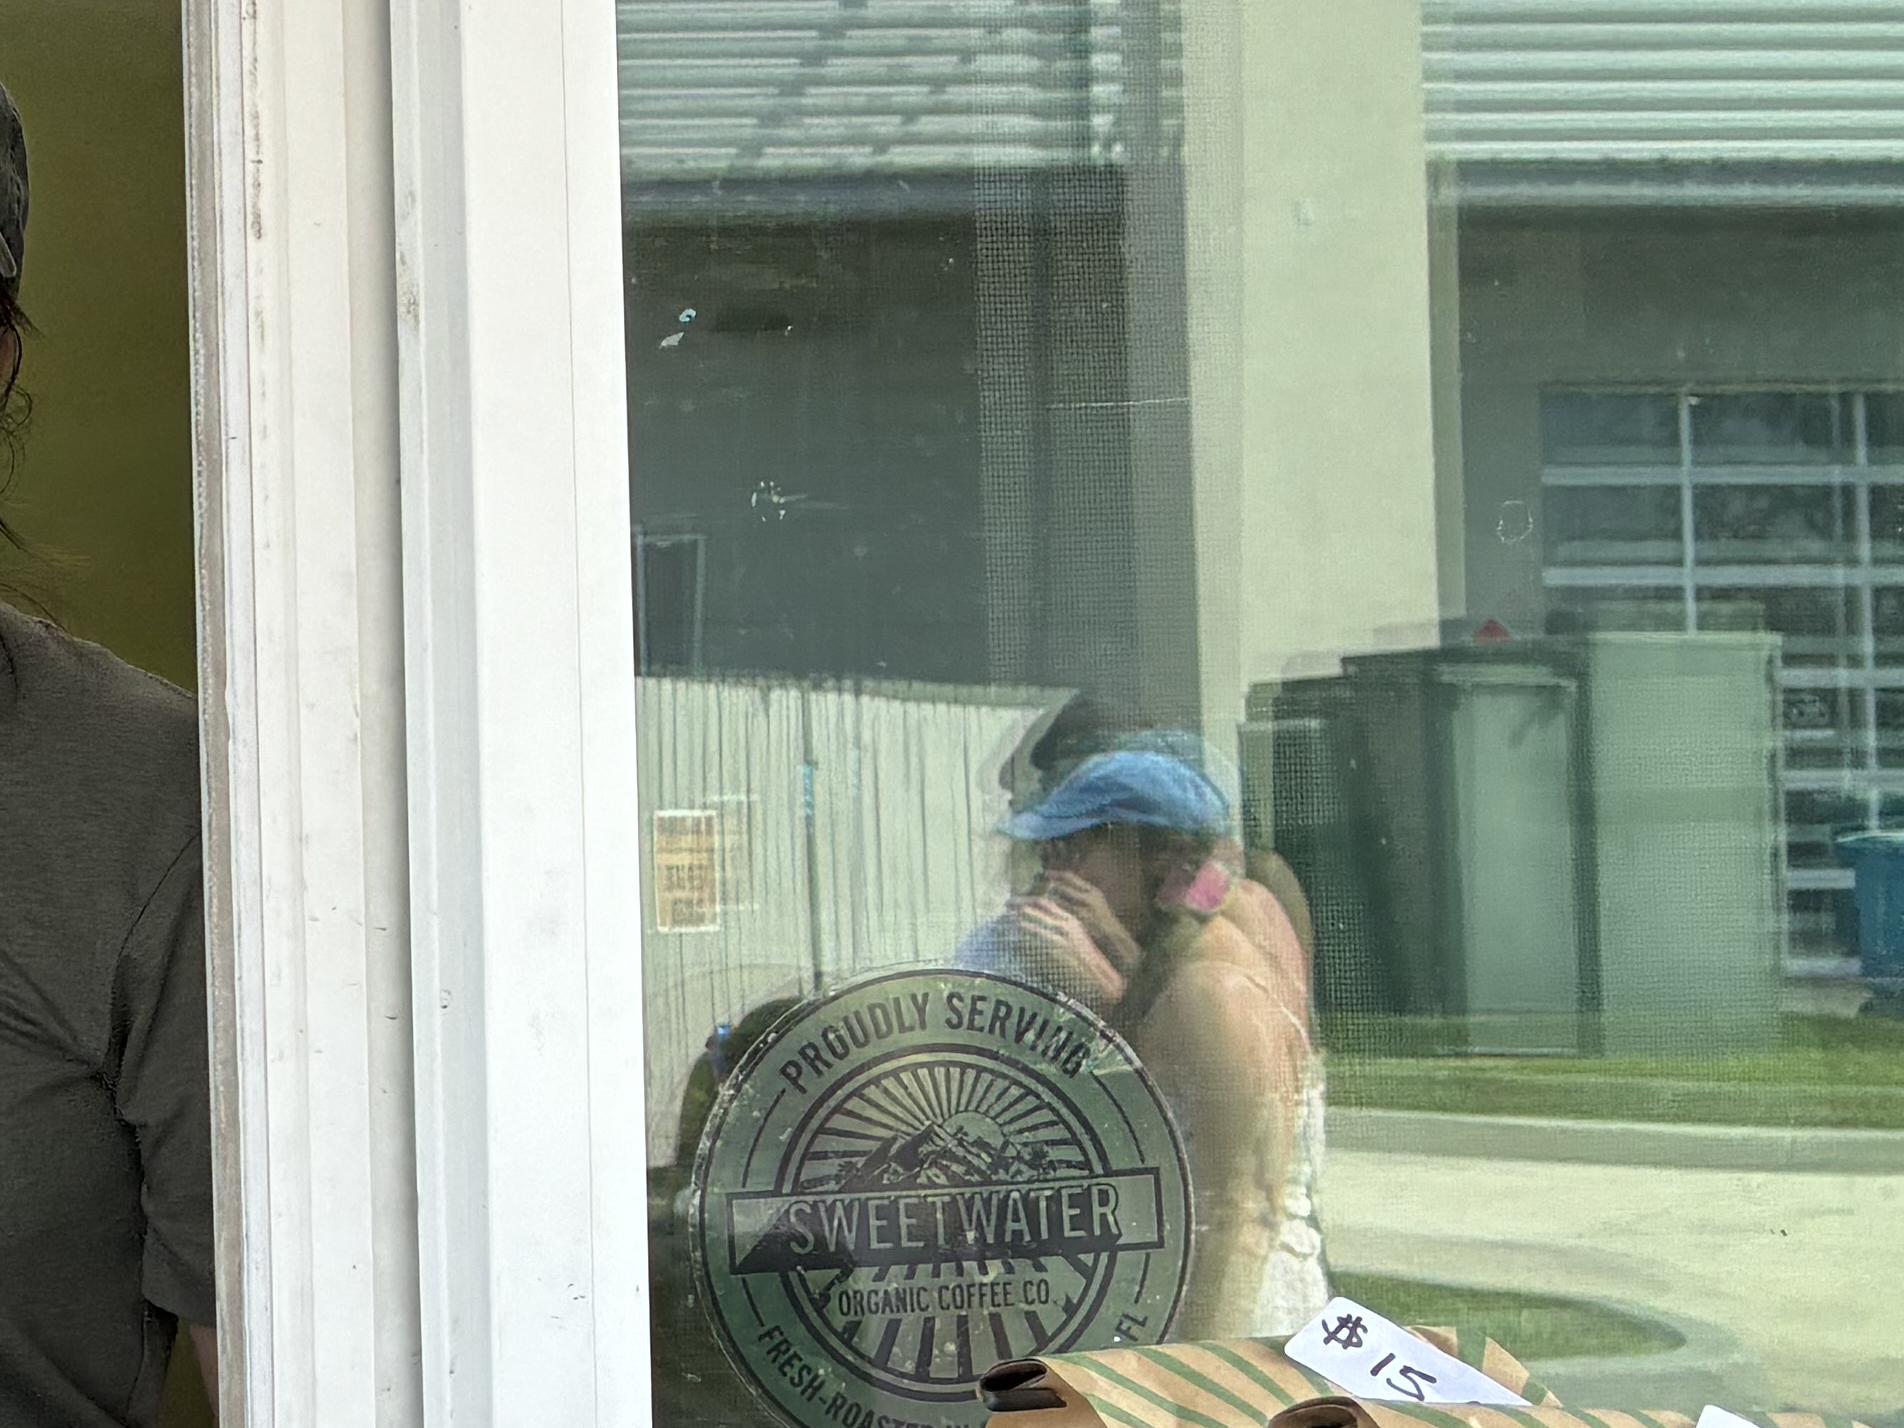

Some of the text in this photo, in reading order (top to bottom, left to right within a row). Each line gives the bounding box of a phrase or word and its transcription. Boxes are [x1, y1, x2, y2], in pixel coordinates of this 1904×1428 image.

[779, 991, 1094, 1094] PROUDLY SERVING
[787, 1183, 1121, 1254] SWEETWATER
[838, 1285, 930, 1317] ORGANIC
[938, 1281, 1014, 1311] COFFEE
